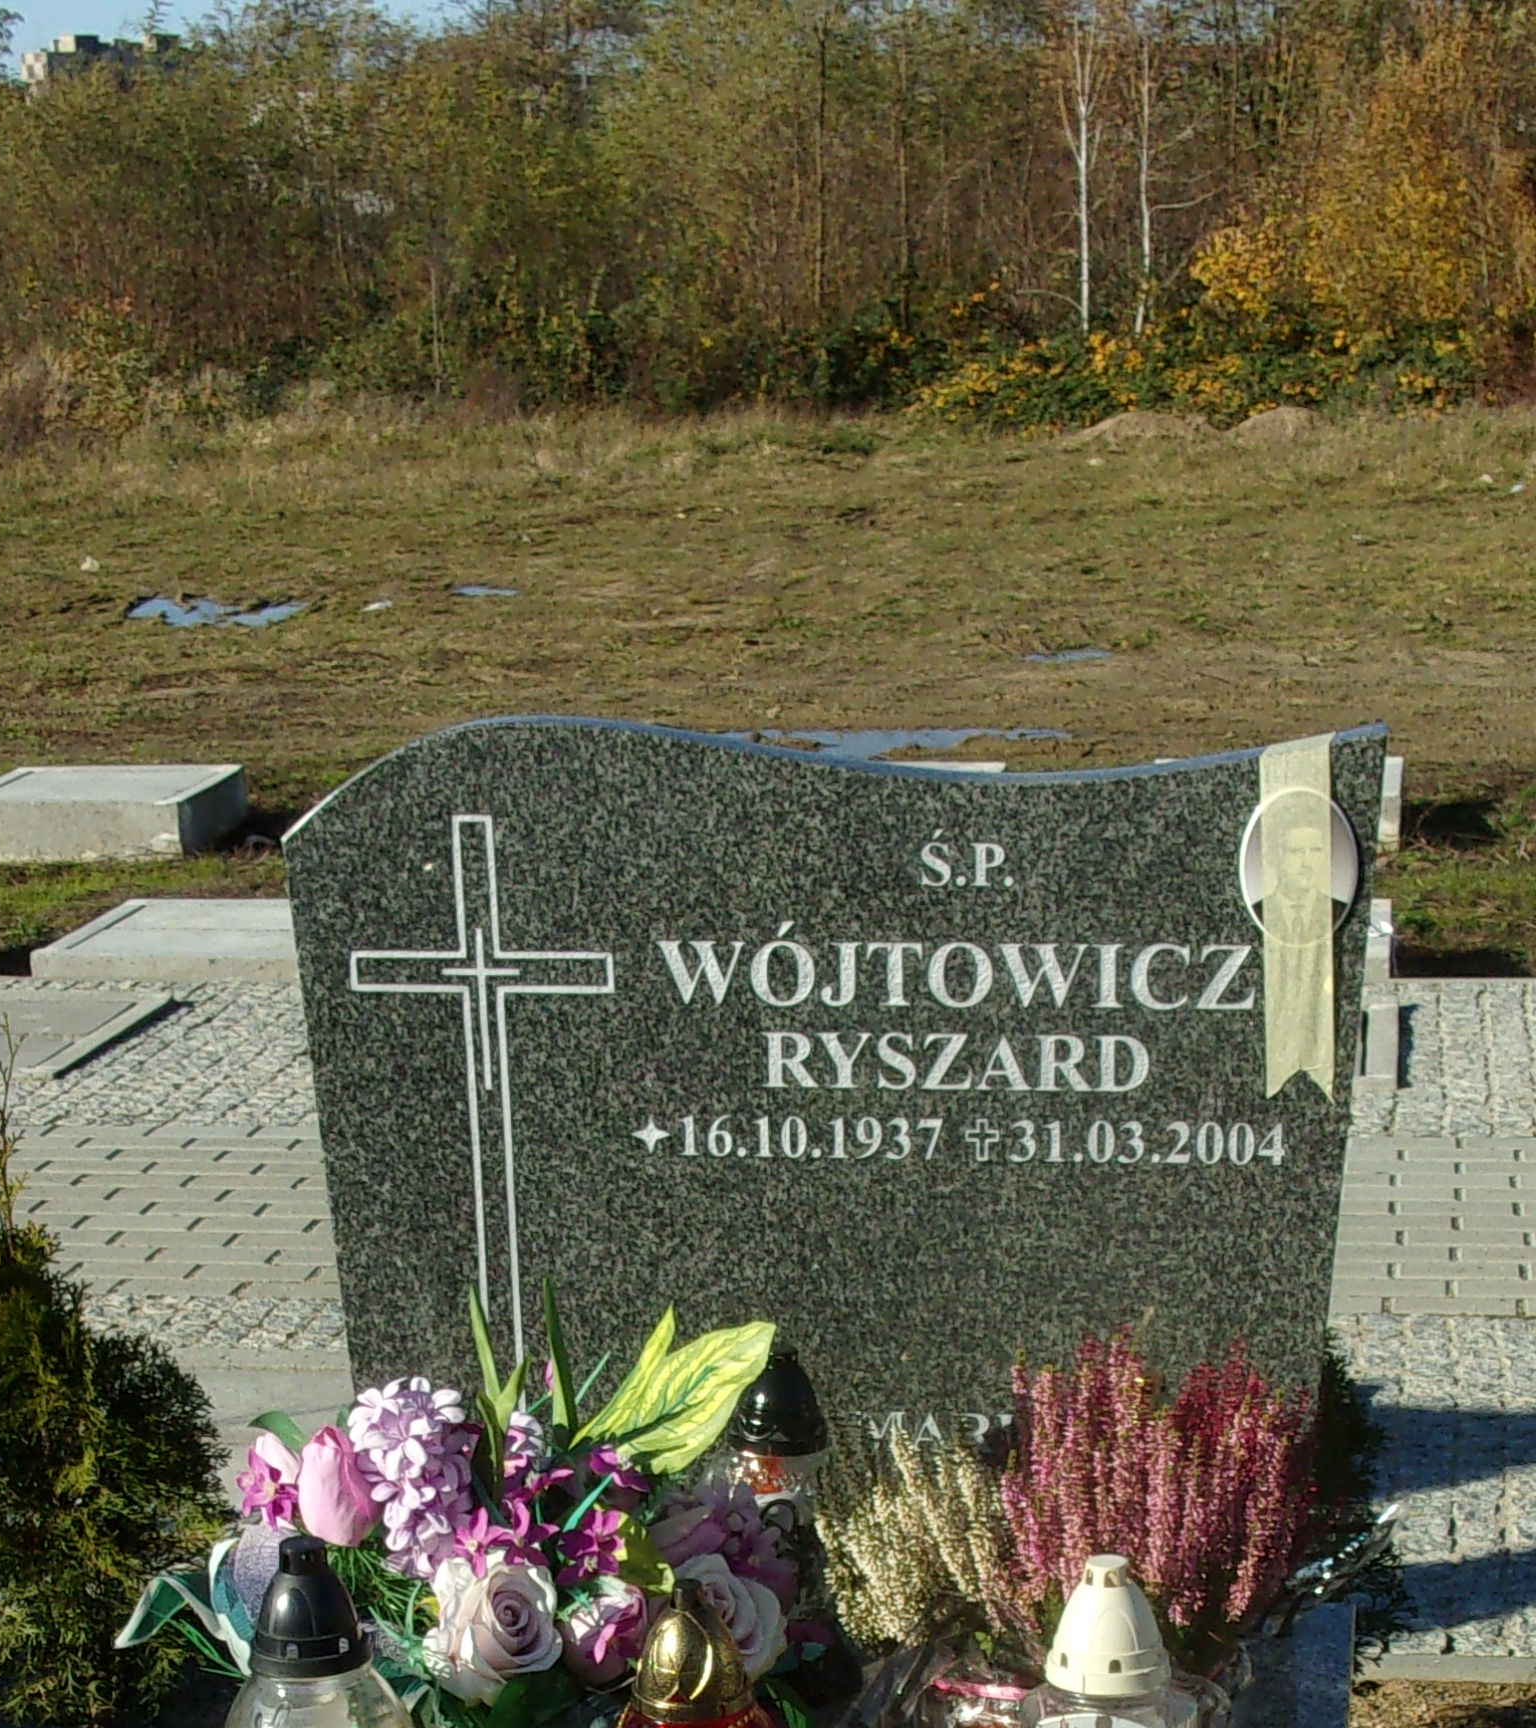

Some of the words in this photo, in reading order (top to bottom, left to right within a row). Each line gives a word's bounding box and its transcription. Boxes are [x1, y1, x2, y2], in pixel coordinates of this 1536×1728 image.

[919, 828, 1015, 888] Ś.P.
[661, 920, 1256, 1011] WÓJTOWICZ
[762, 1030, 1151, 1093] RYSZARD
